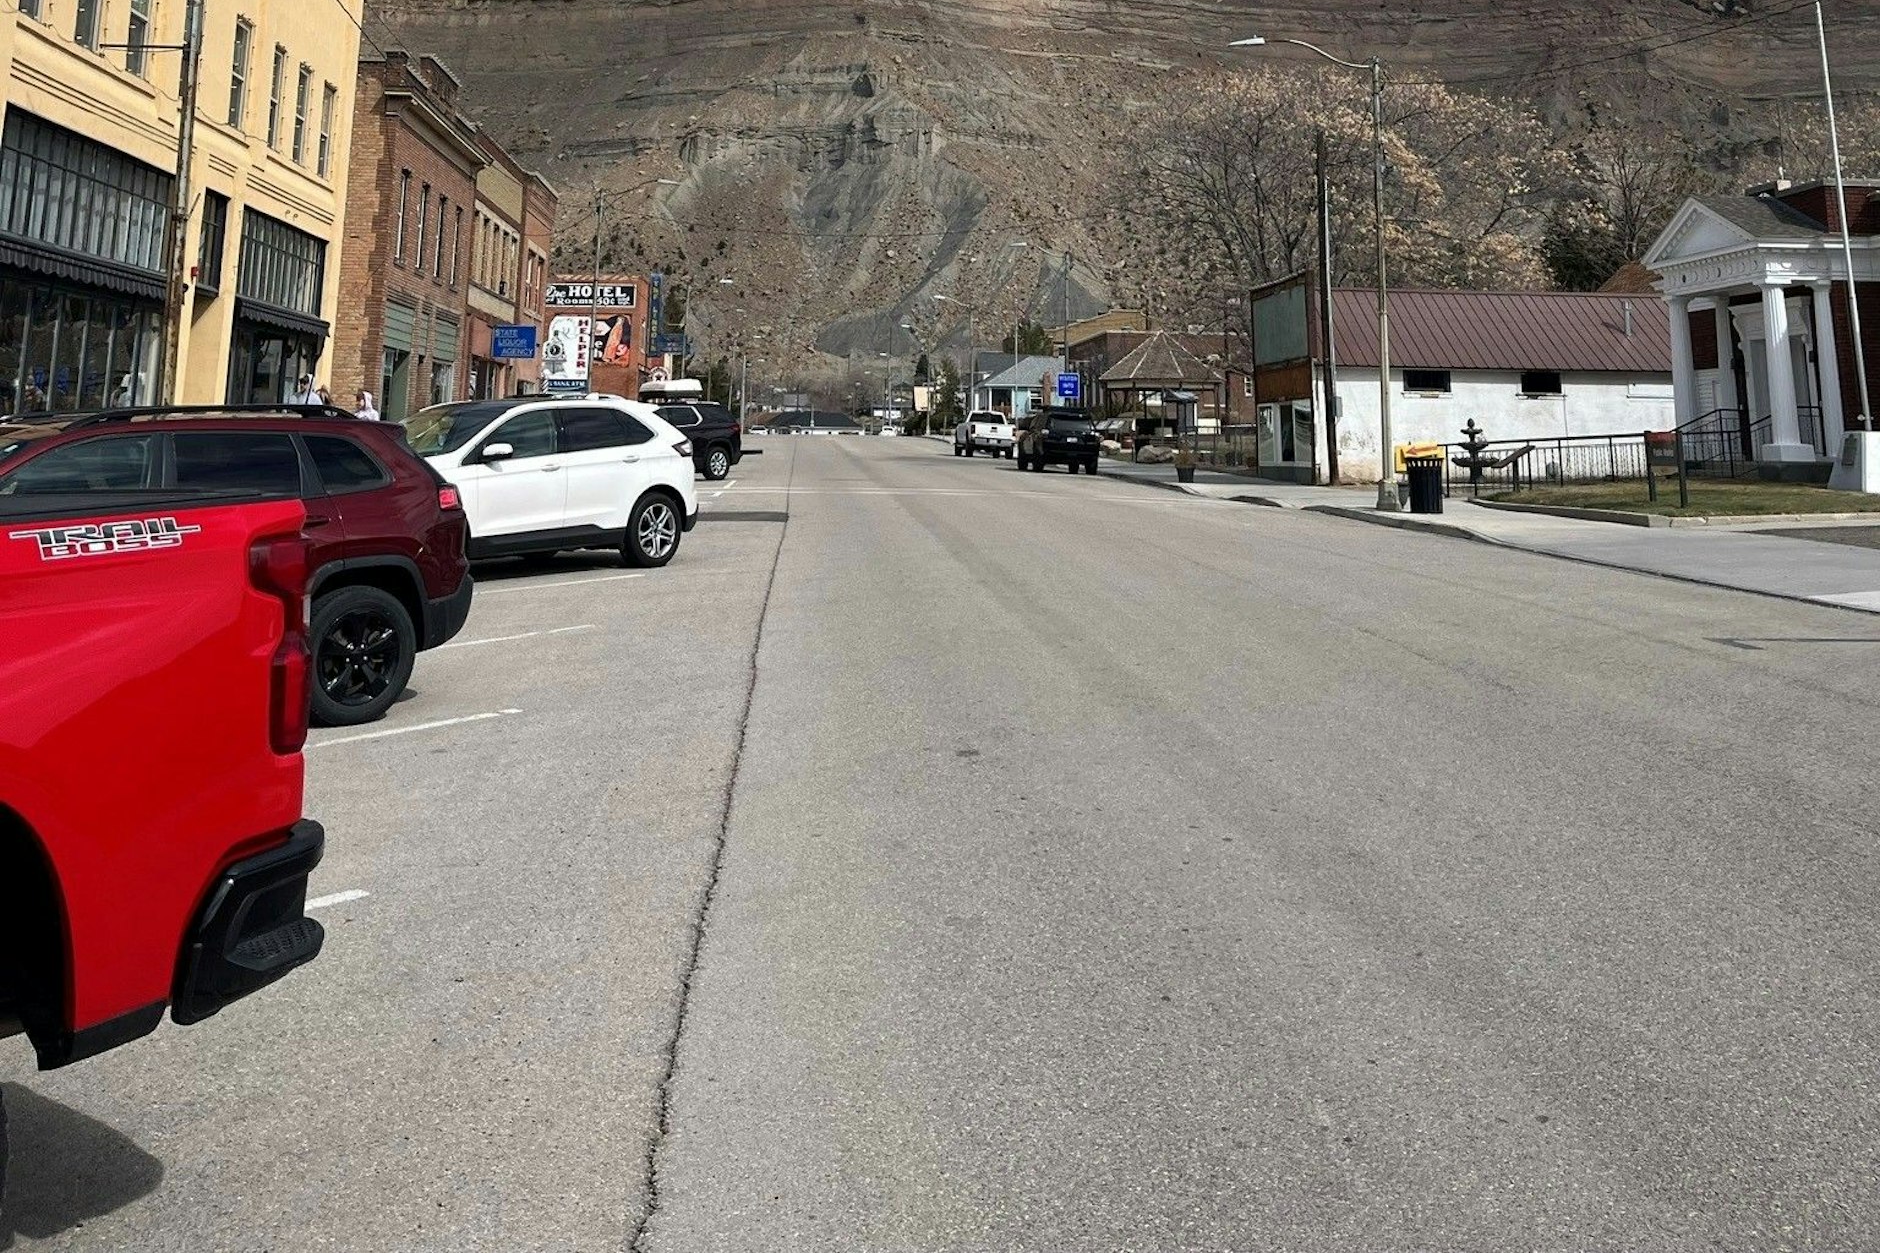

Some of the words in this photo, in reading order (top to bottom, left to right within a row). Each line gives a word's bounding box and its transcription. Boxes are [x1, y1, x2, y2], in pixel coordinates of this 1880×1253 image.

[568, 286, 627, 298] HOTEL
[495, 329, 519, 338] STATE
[498, 338, 528, 347] LIQUOR
[576, 319, 589, 368] HELPER
[502, 347, 534, 356] AGENCY
[9, 517, 201, 546] TRAIL
[41, 533, 183, 561] BOSS
